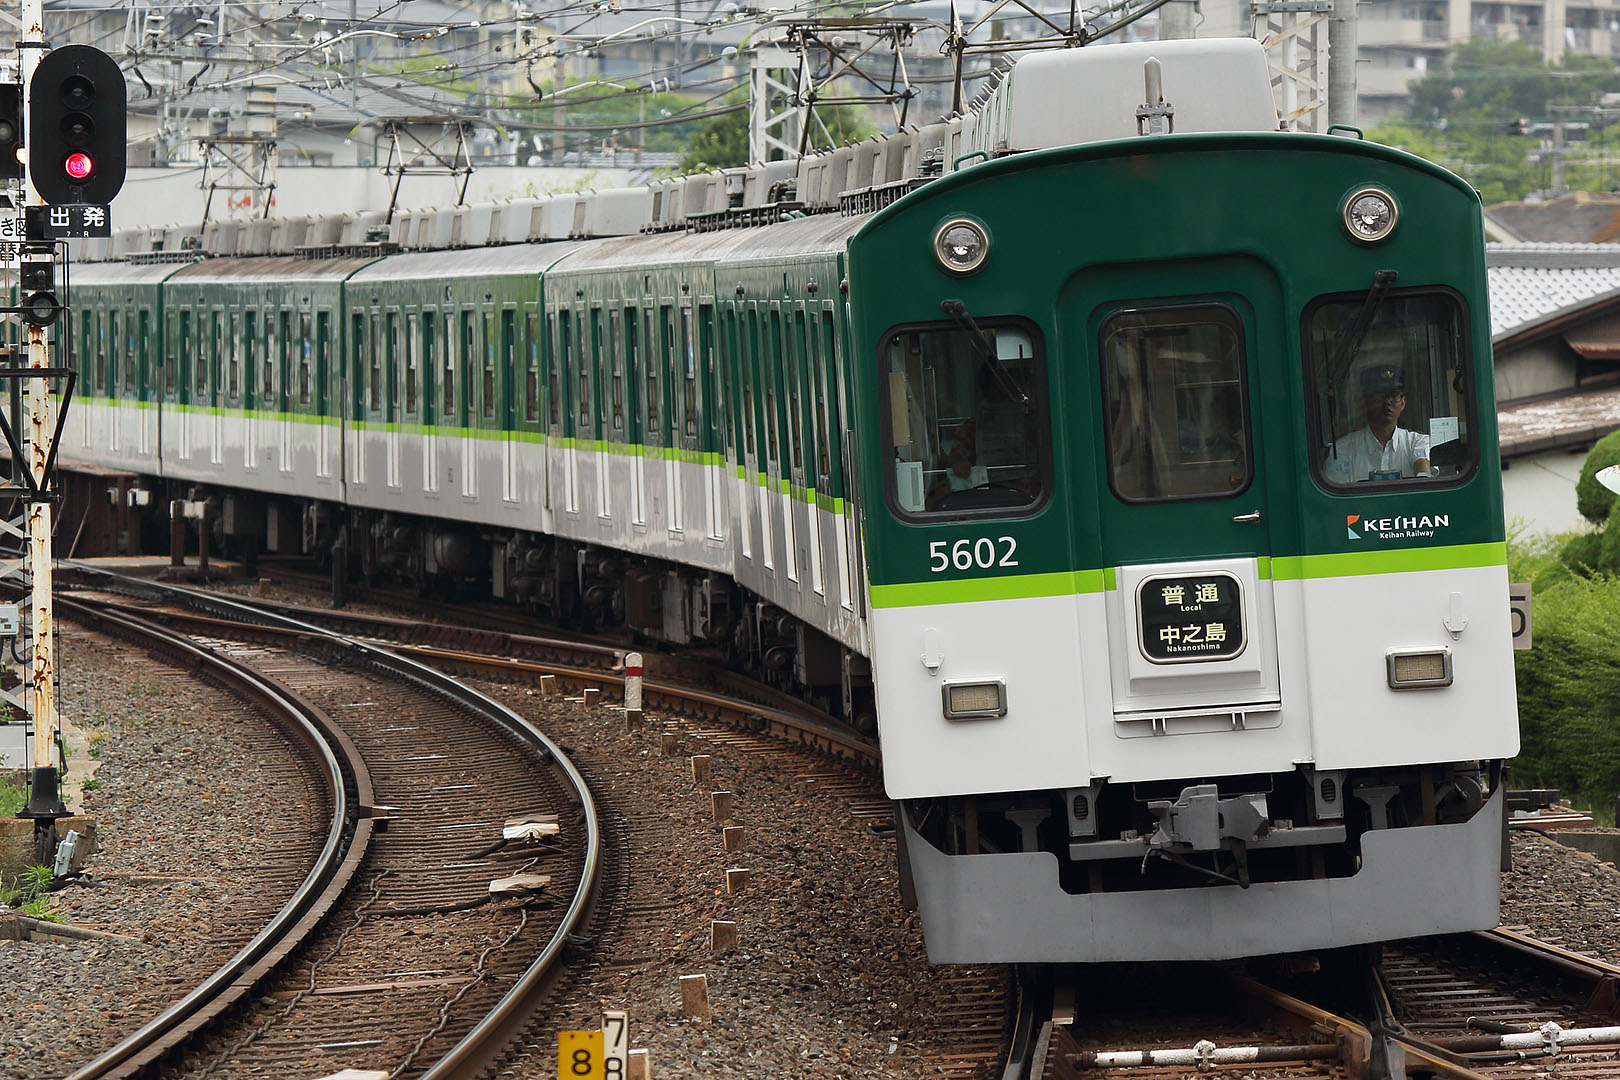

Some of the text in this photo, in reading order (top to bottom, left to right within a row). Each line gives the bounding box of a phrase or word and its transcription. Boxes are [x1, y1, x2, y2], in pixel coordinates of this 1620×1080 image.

[50, 206, 105, 227] 出発
[1363, 514, 1450, 532] KEIHAN
[1379, 529, 1435, 540] Keihan Railway
[929, 536, 1019, 573] 5602
[1161, 582, 1219, 606] 普通
[1180, 603, 1202, 612] Local
[1159, 622, 1227, 645] 中之島
[1166, 642, 1221, 653] Nakanoshima
[571, 1048, 592, 1077] 8
